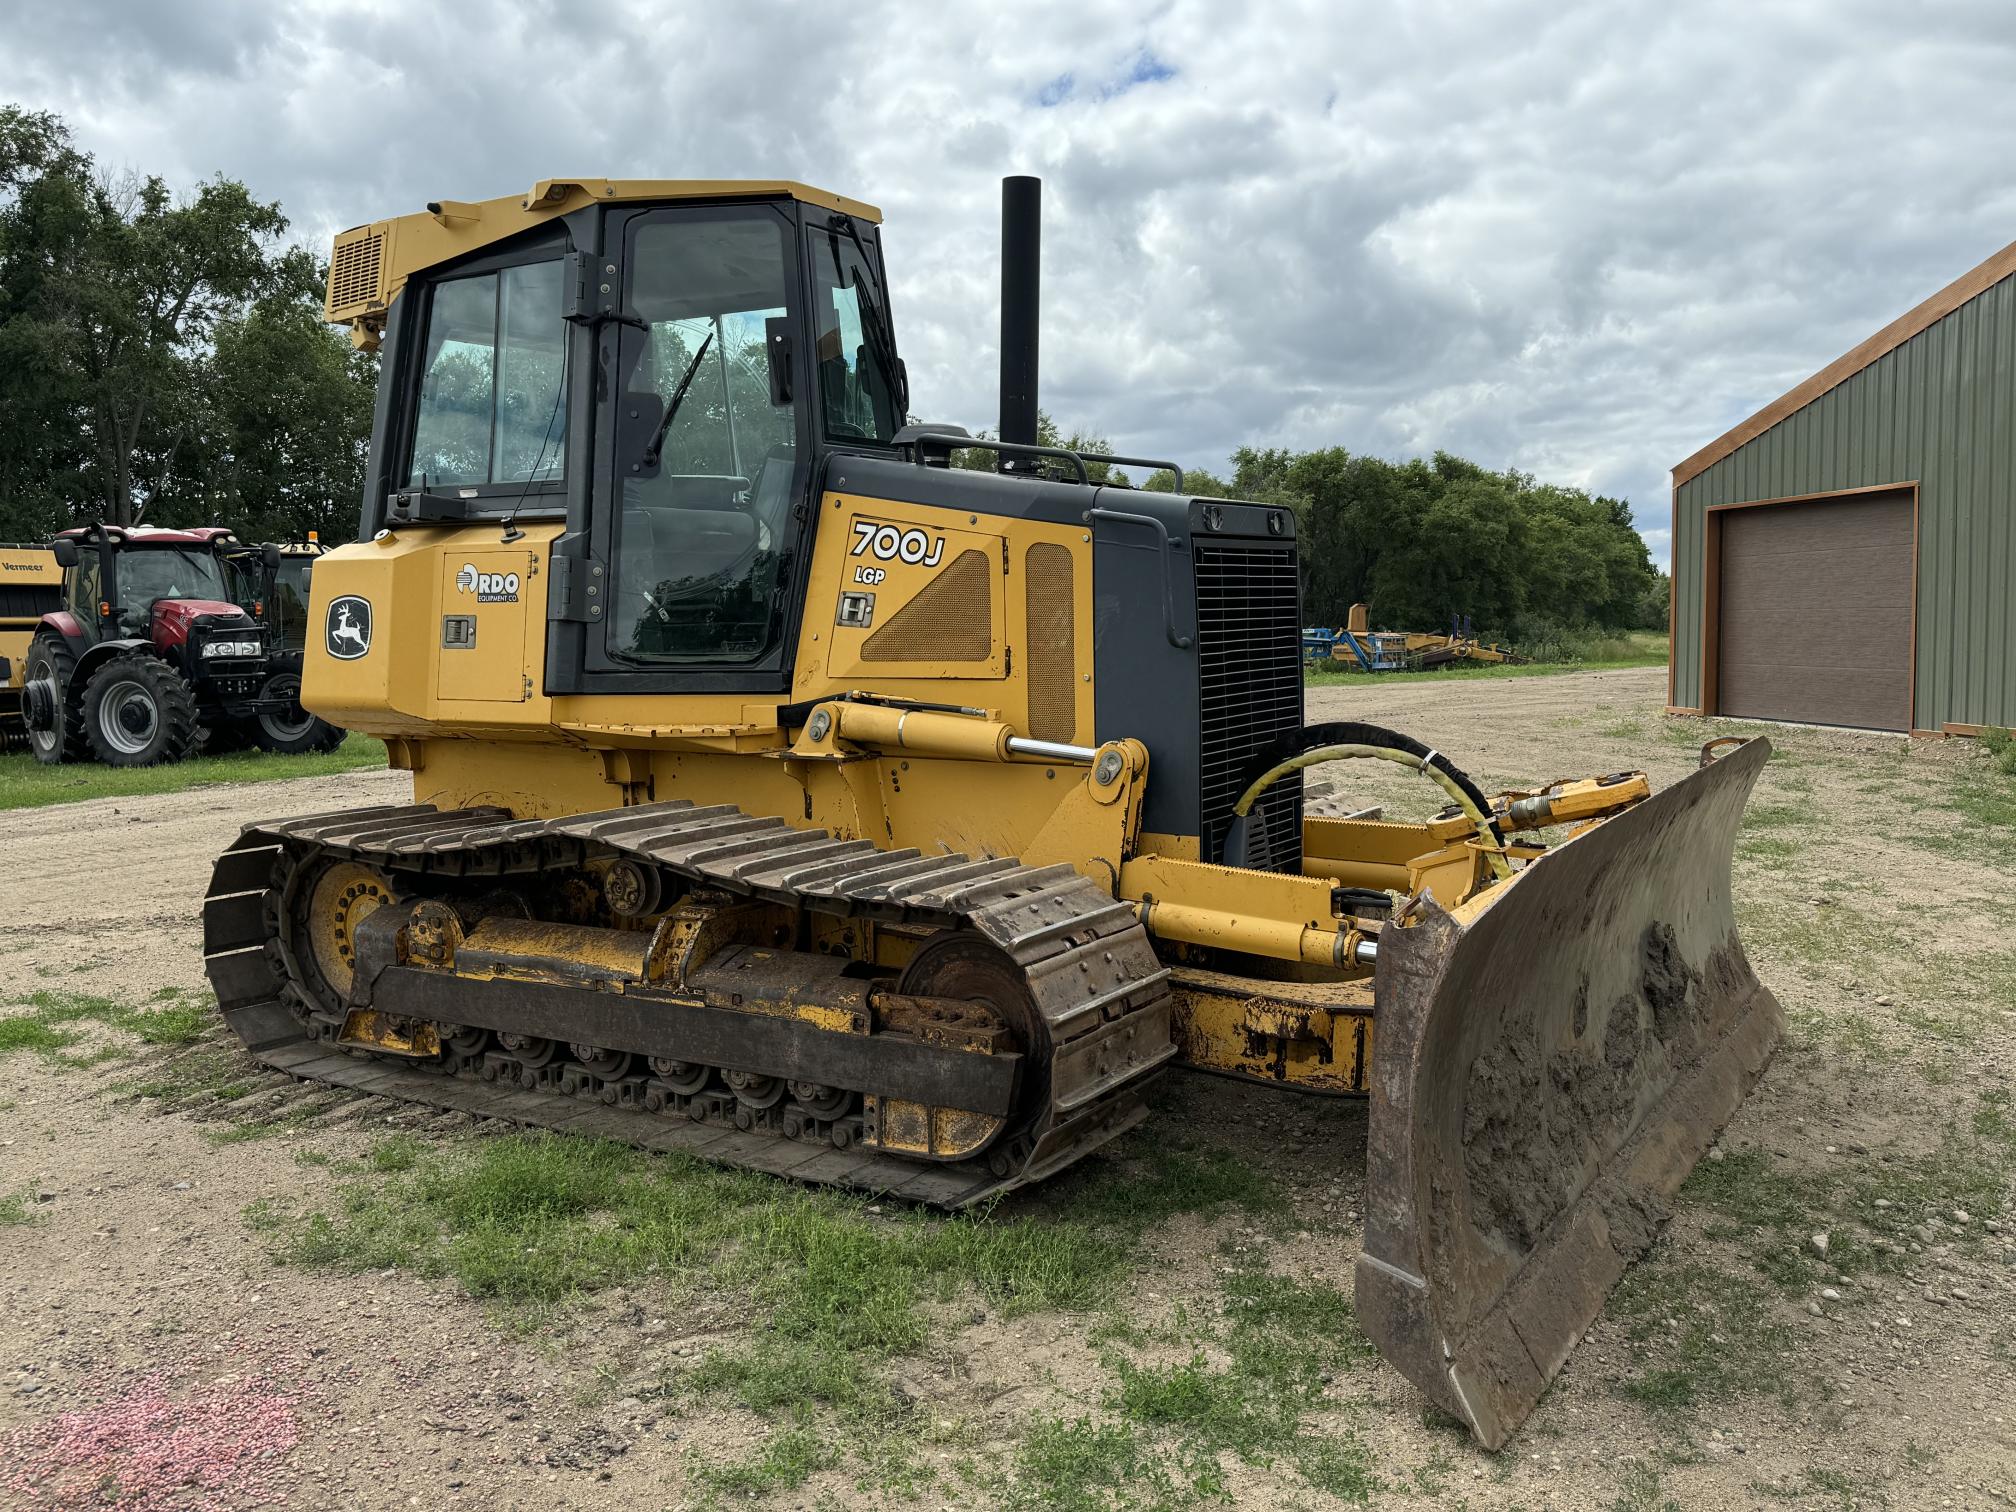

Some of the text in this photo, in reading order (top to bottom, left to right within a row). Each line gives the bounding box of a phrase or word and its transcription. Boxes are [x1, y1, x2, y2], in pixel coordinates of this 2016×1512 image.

[850, 521, 945, 567] 700J
[2, 562, 44, 571] Vermeer
[854, 566, 885, 585] LGP
